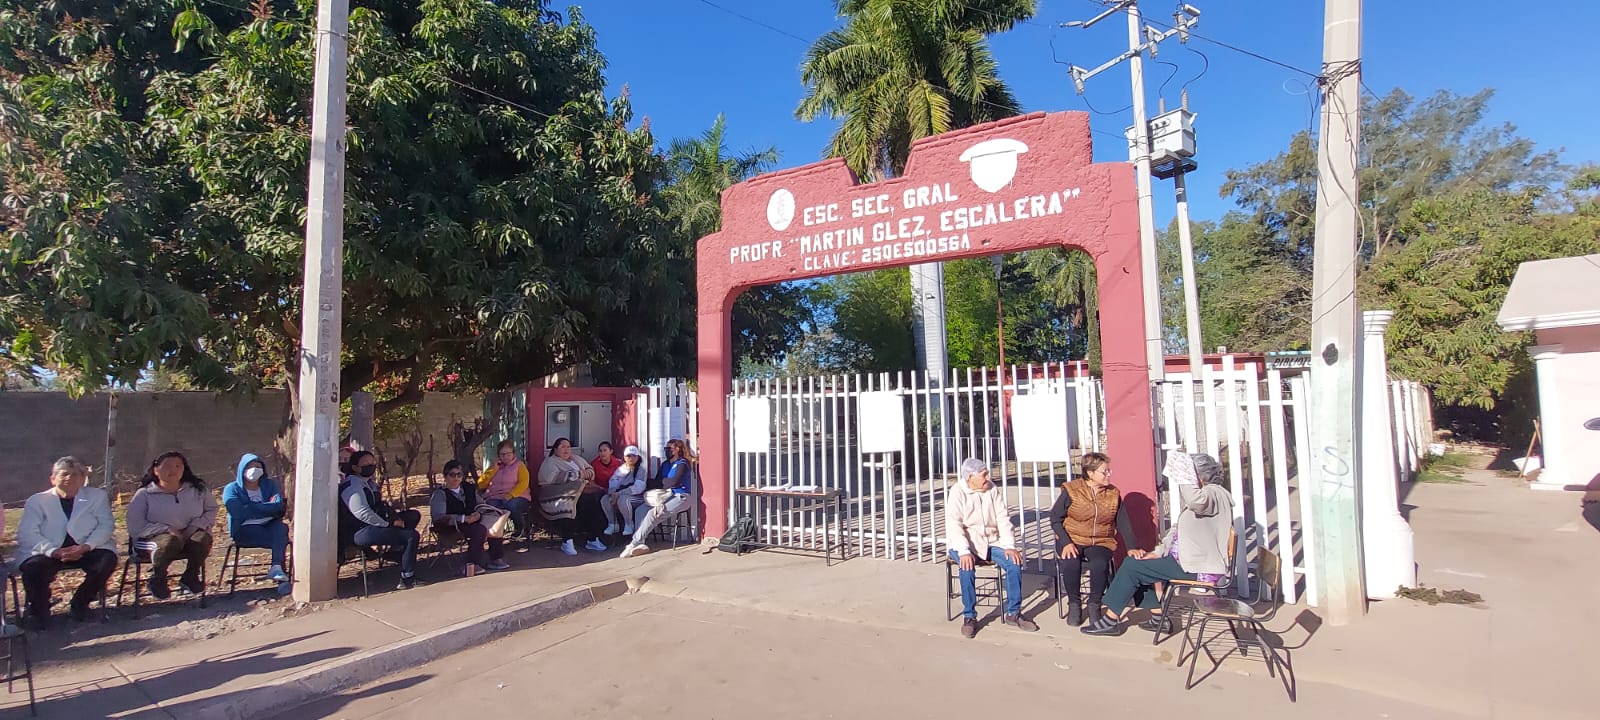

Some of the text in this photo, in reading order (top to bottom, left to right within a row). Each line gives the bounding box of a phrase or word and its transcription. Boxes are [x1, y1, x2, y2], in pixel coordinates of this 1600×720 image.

[803, 203, 843, 226] ESC.
[903, 183, 958, 209] GRAL
[804, 250, 856, 271] CLAVE:
